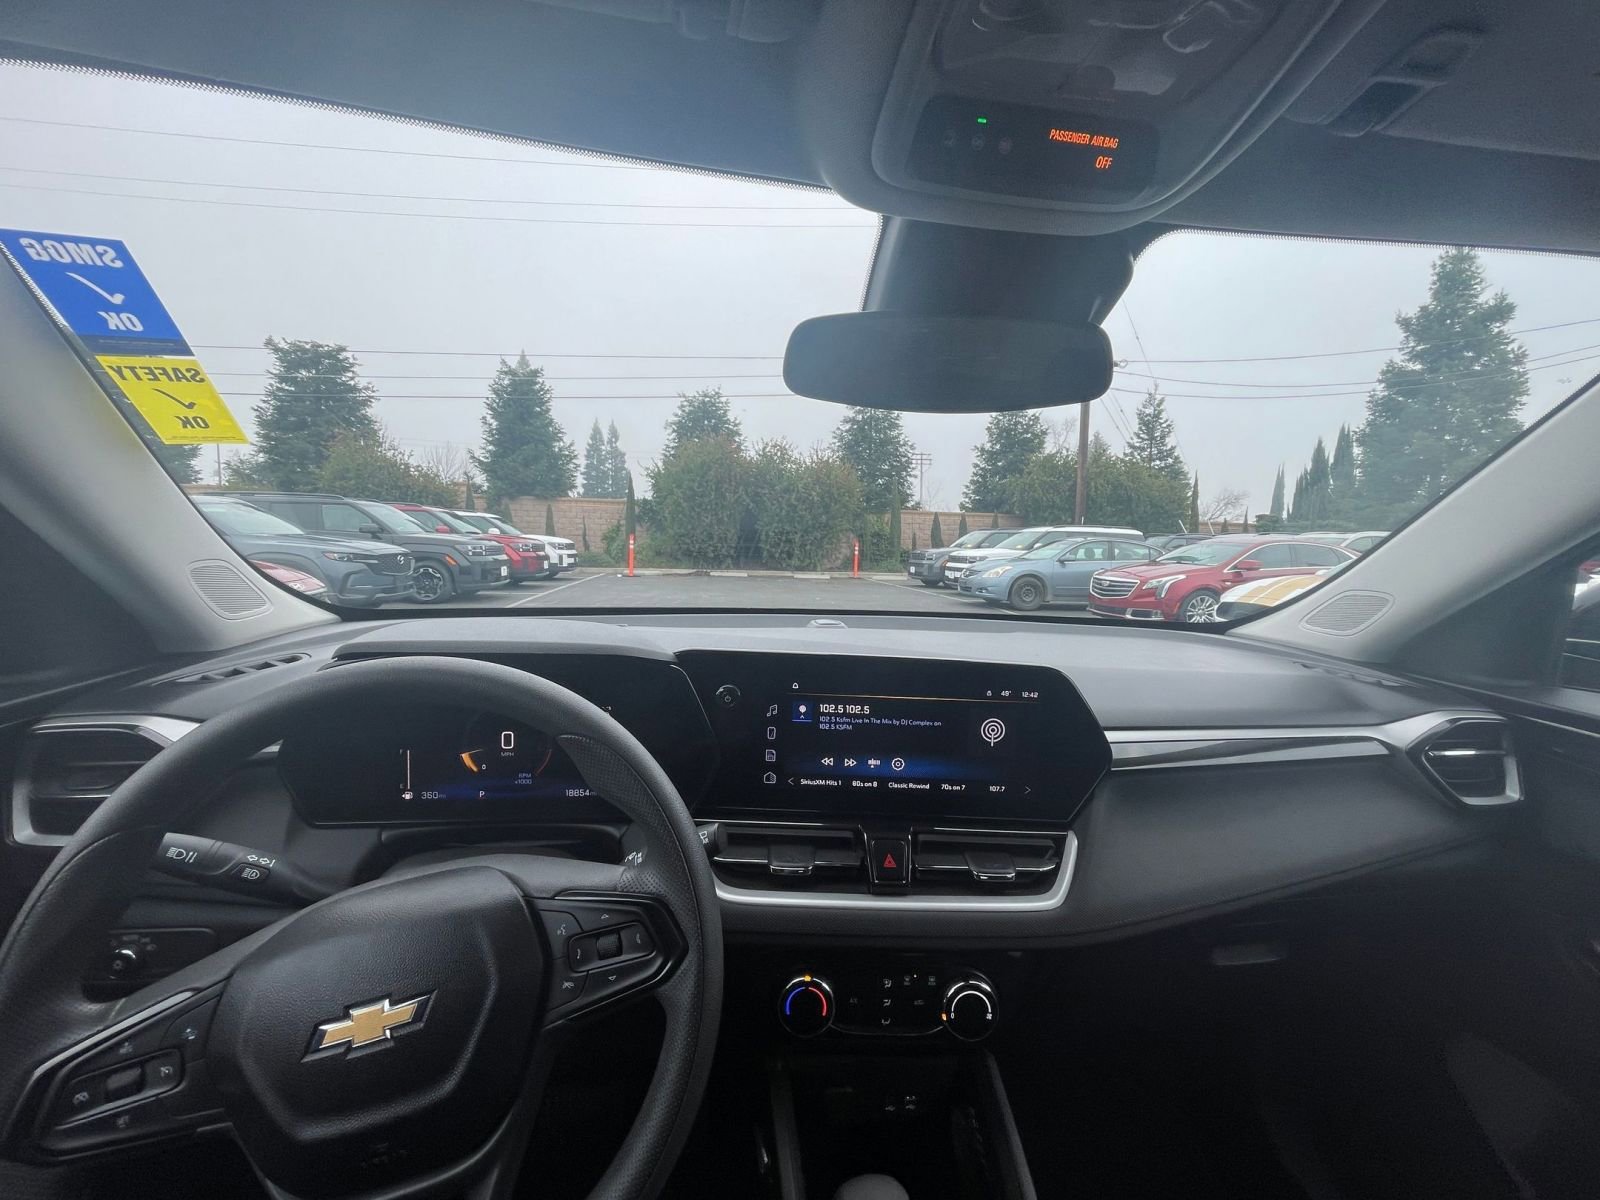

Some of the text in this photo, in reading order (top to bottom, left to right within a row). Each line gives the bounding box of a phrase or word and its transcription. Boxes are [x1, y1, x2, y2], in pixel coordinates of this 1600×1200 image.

[1049, 129, 1090, 144] PASSENGER
[1095, 156, 1113, 169] OFF
[819, 704, 870, 714] 102.5 102.5
[819, 715, 836, 723] 102.5
[870, 717, 881, 725] The
[908, 719, 933, 727] Complex
[501, 731, 514, 749] 0
[800, 778, 825, 786] SiriusXM
[825, 779, 838, 787] Hits
[888, 781, 930, 790] Classic Rewind
[941, 783, 952, 791] 70s
[989, 785, 1006, 793] 107.7
[479, 791, 485, 799] P
